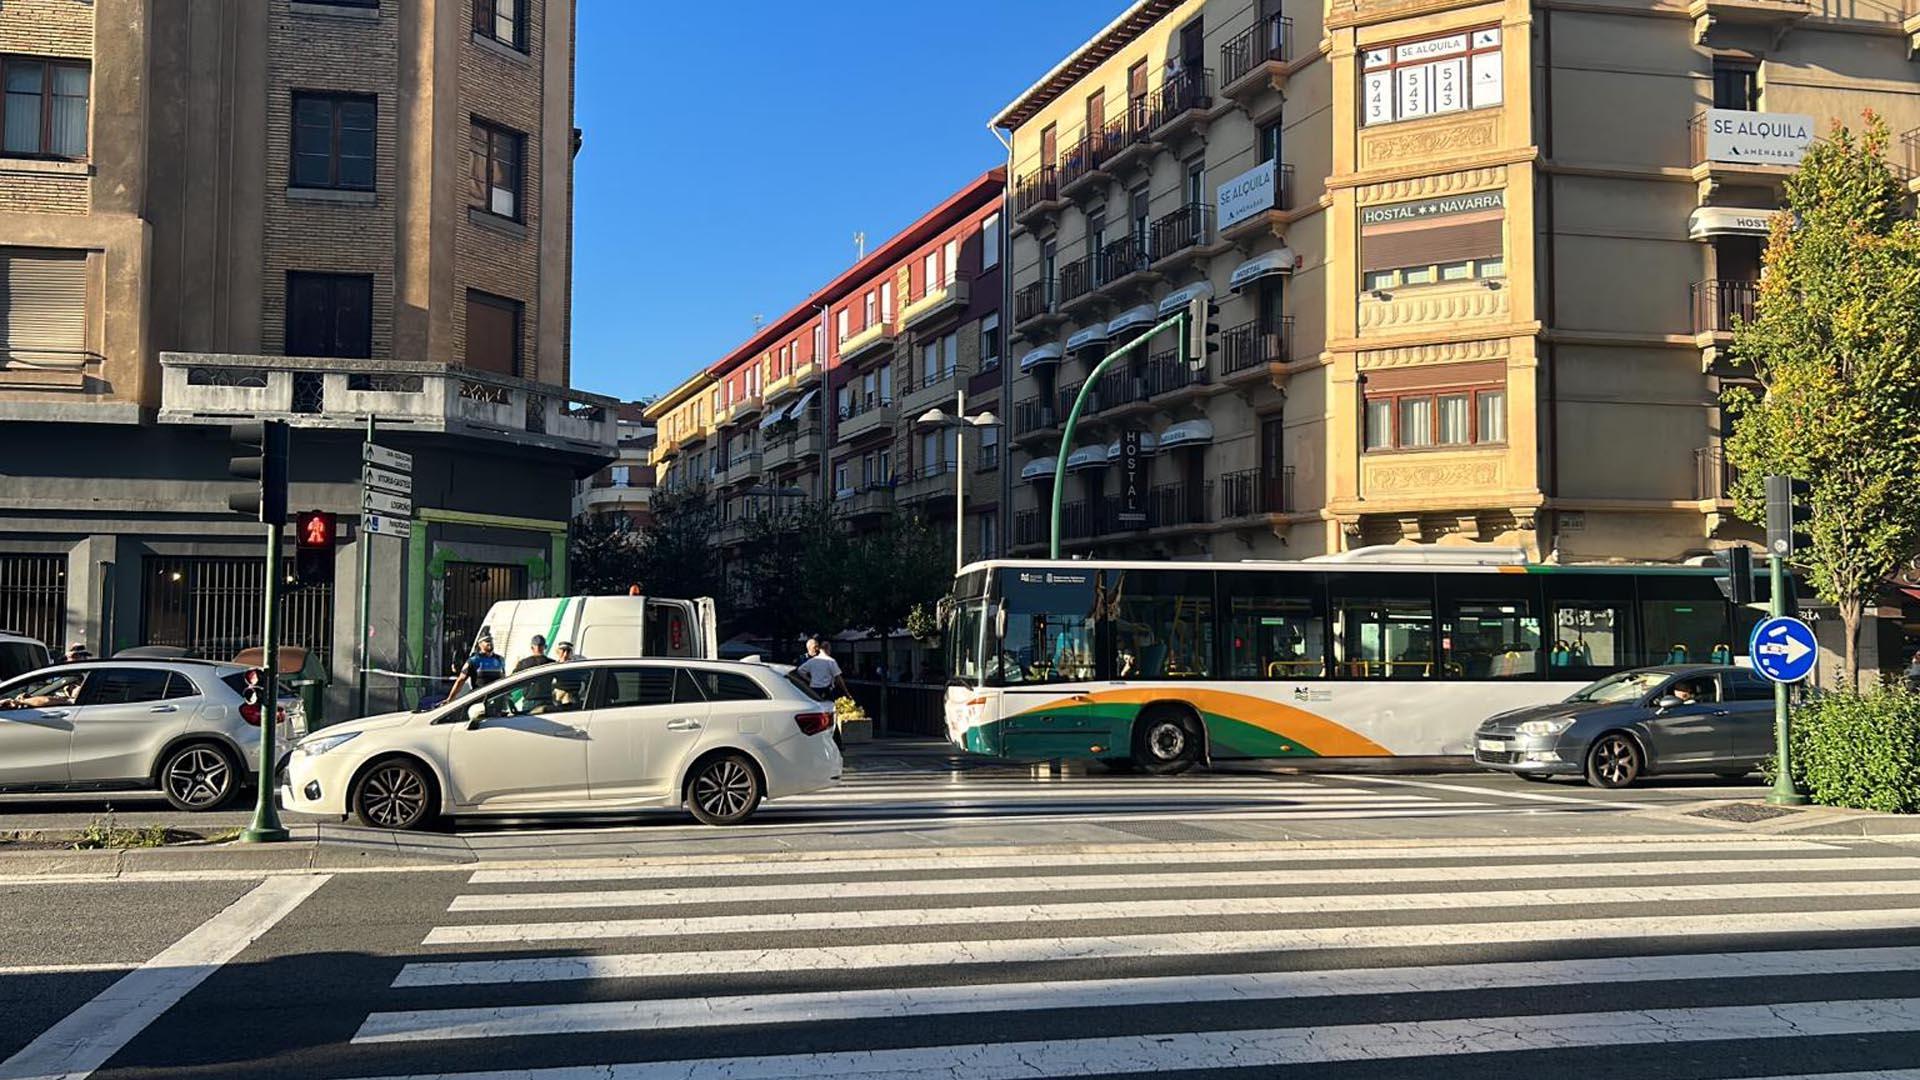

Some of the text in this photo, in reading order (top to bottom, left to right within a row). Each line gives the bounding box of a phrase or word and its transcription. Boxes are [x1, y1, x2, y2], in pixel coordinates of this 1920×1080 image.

[1401, 39, 1461, 57] SE ALQUILA
[1714, 119, 1807, 139] SE ALQUILA
[1743, 148, 1794, 157] AMENABAR
[1220, 172, 1270, 206] SE ALQUILA
[1365, 195, 1501, 222] HOSTAL NAVARRA
[1737, 218, 1768, 228] HOST
[1126, 432, 1137, 510] HOSTAL
